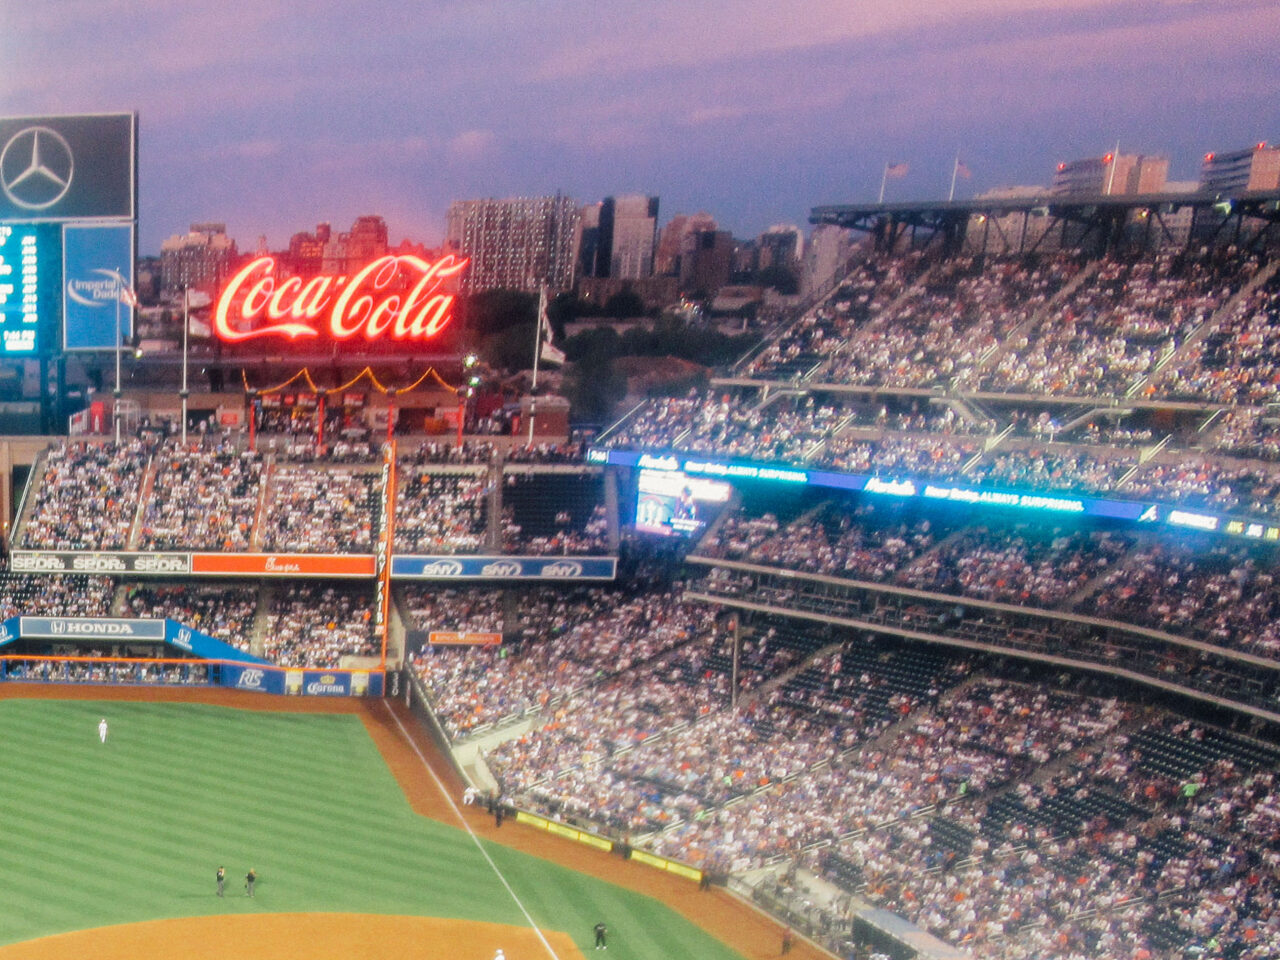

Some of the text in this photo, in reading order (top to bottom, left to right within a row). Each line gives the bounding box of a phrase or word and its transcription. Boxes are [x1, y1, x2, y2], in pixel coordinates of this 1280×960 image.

[75, 279, 116, 291] Imperial
[980, 492, 1019, 505] ALWAYS
[422, 563, 572, 578] SNY SNY SNY
[67, 623, 134, 635] HONDA
[307, 682, 345, 696] Corona
